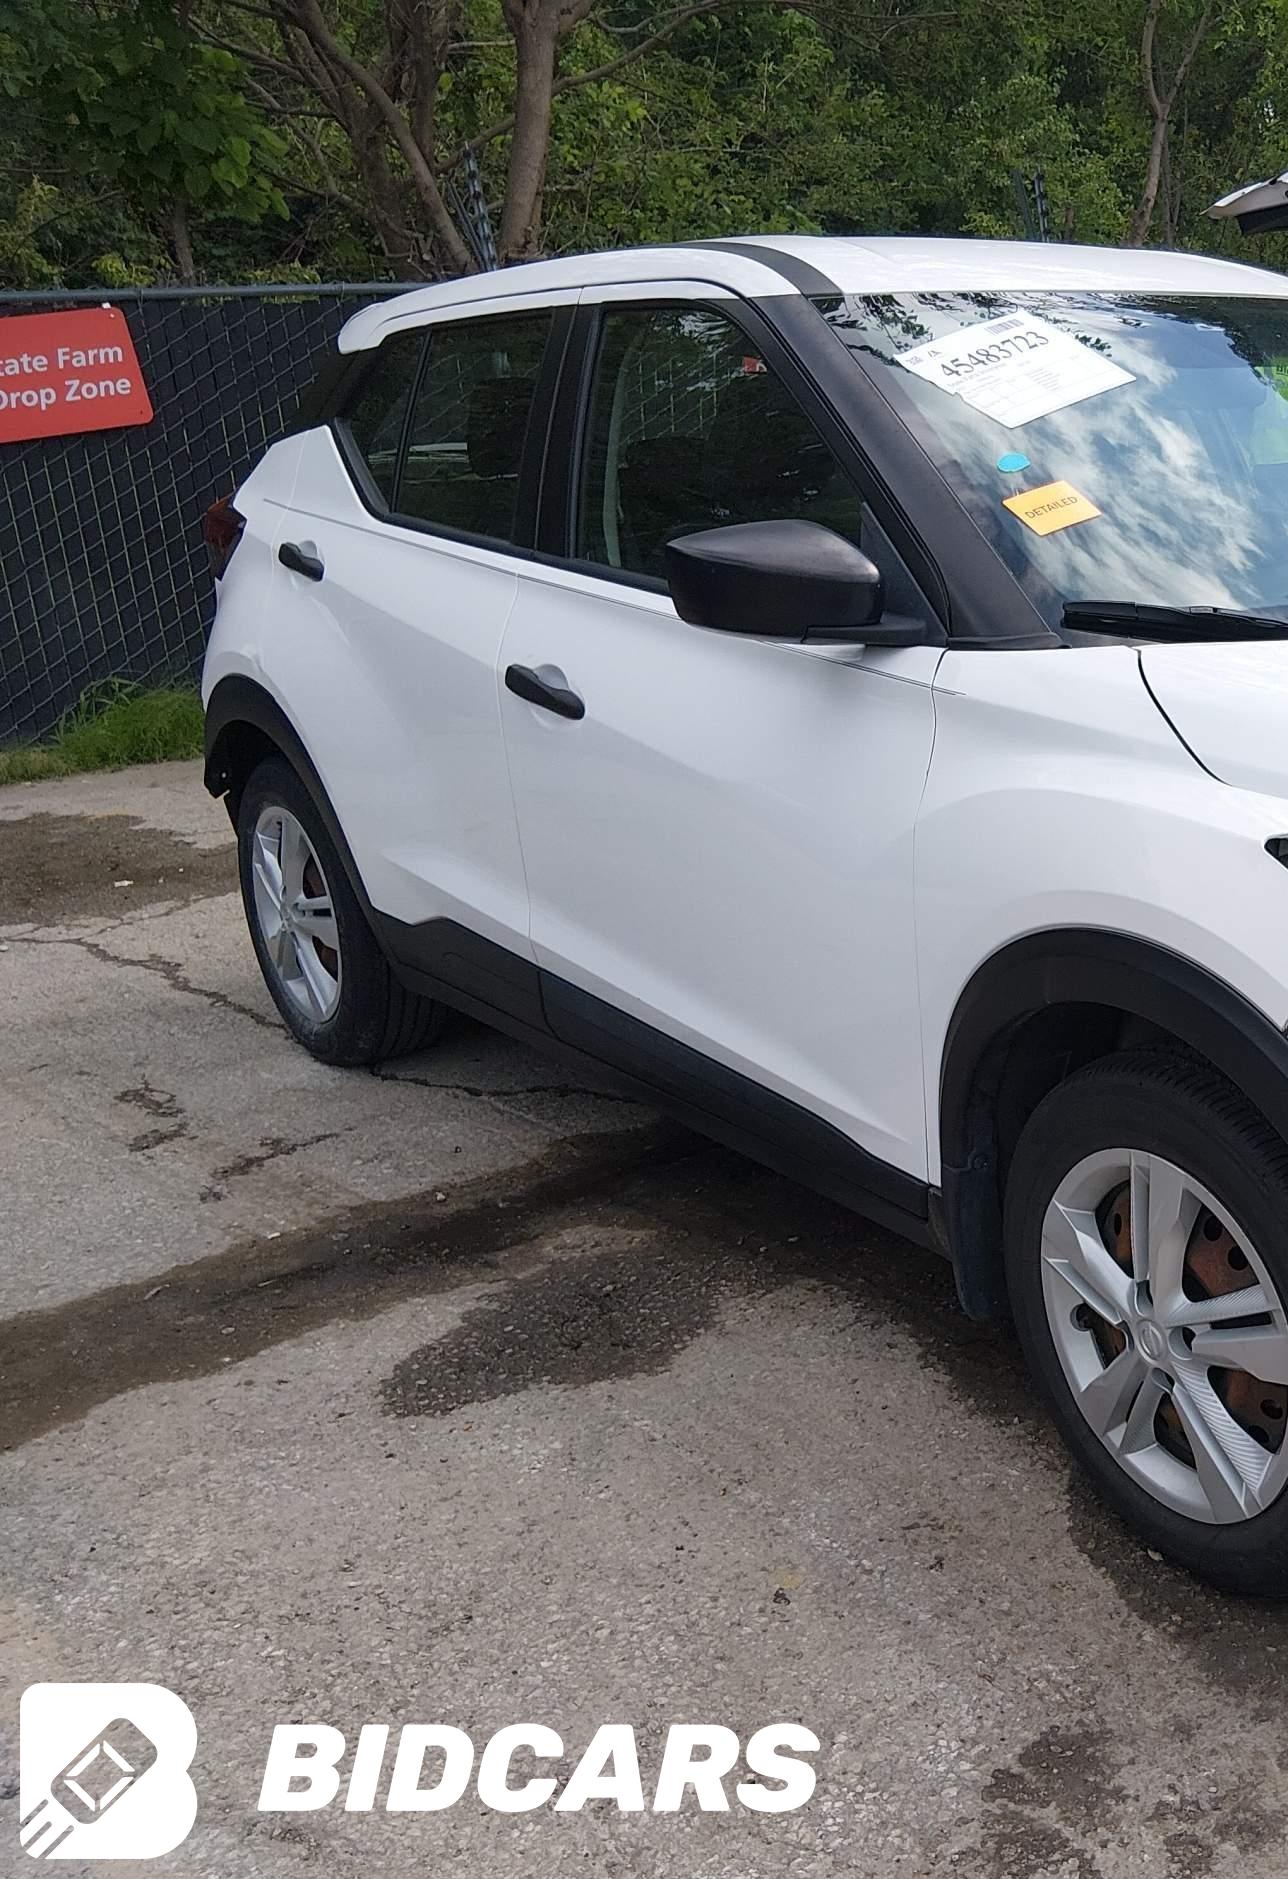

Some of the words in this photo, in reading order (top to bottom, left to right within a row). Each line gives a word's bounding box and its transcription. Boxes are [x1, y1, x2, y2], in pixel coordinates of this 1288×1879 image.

[57, 345, 123, 369] Farm
[939, 331, 1049, 377] 45483723
[65, 377, 131, 402] Zone
[1024, 496, 1078, 519] DETAILED
